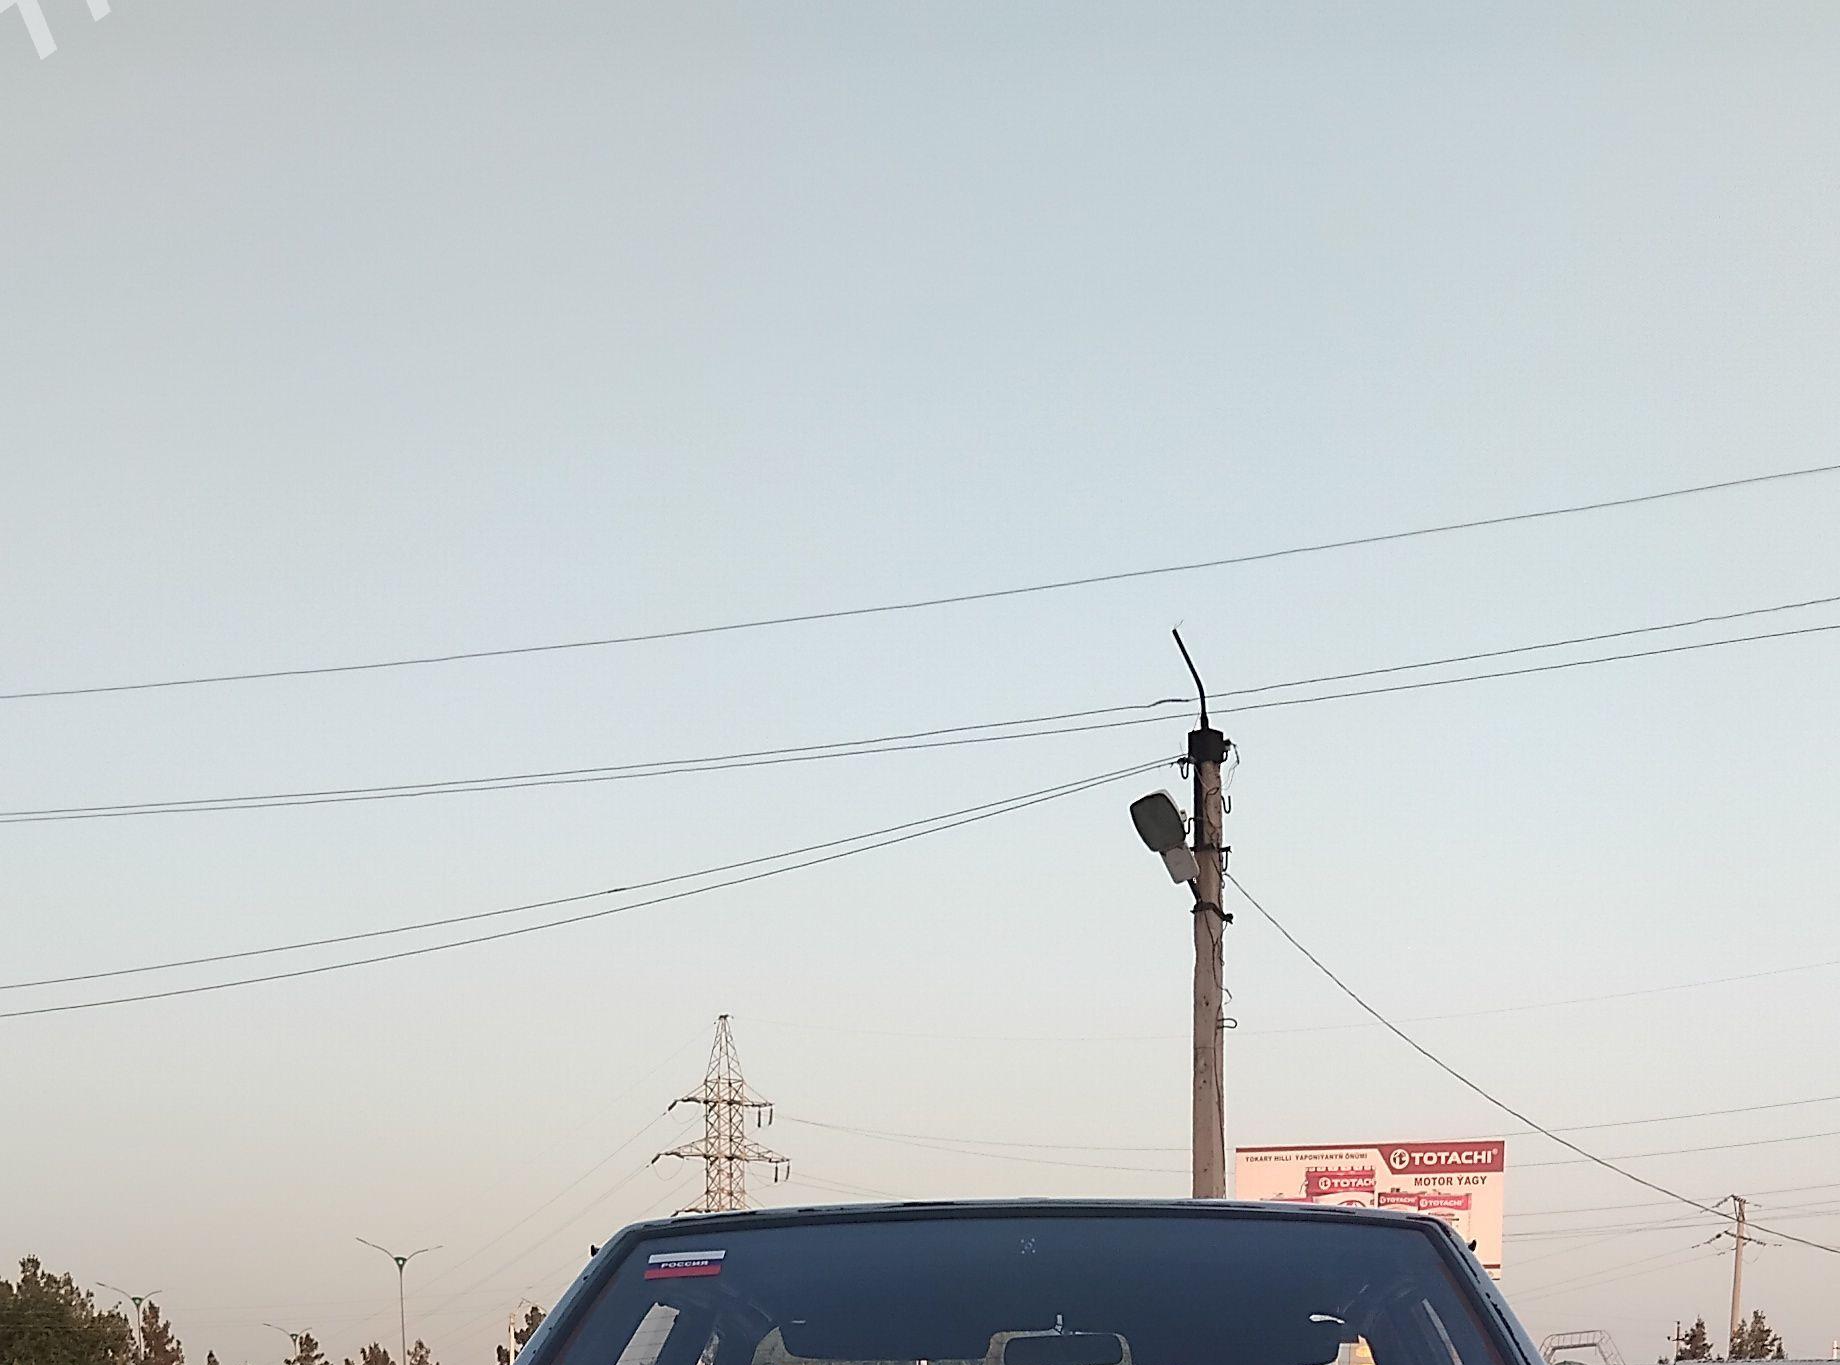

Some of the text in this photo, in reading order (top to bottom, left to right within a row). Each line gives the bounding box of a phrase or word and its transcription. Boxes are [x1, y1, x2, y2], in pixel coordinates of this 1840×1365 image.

[1411, 1150, 1493, 1166] TOTACHI
[1414, 1176, 1453, 1187] MOTOR
[1429, 1199, 1463, 1207] TOTACHI
[661, 1260, 709, 1268] РОССИЯ
